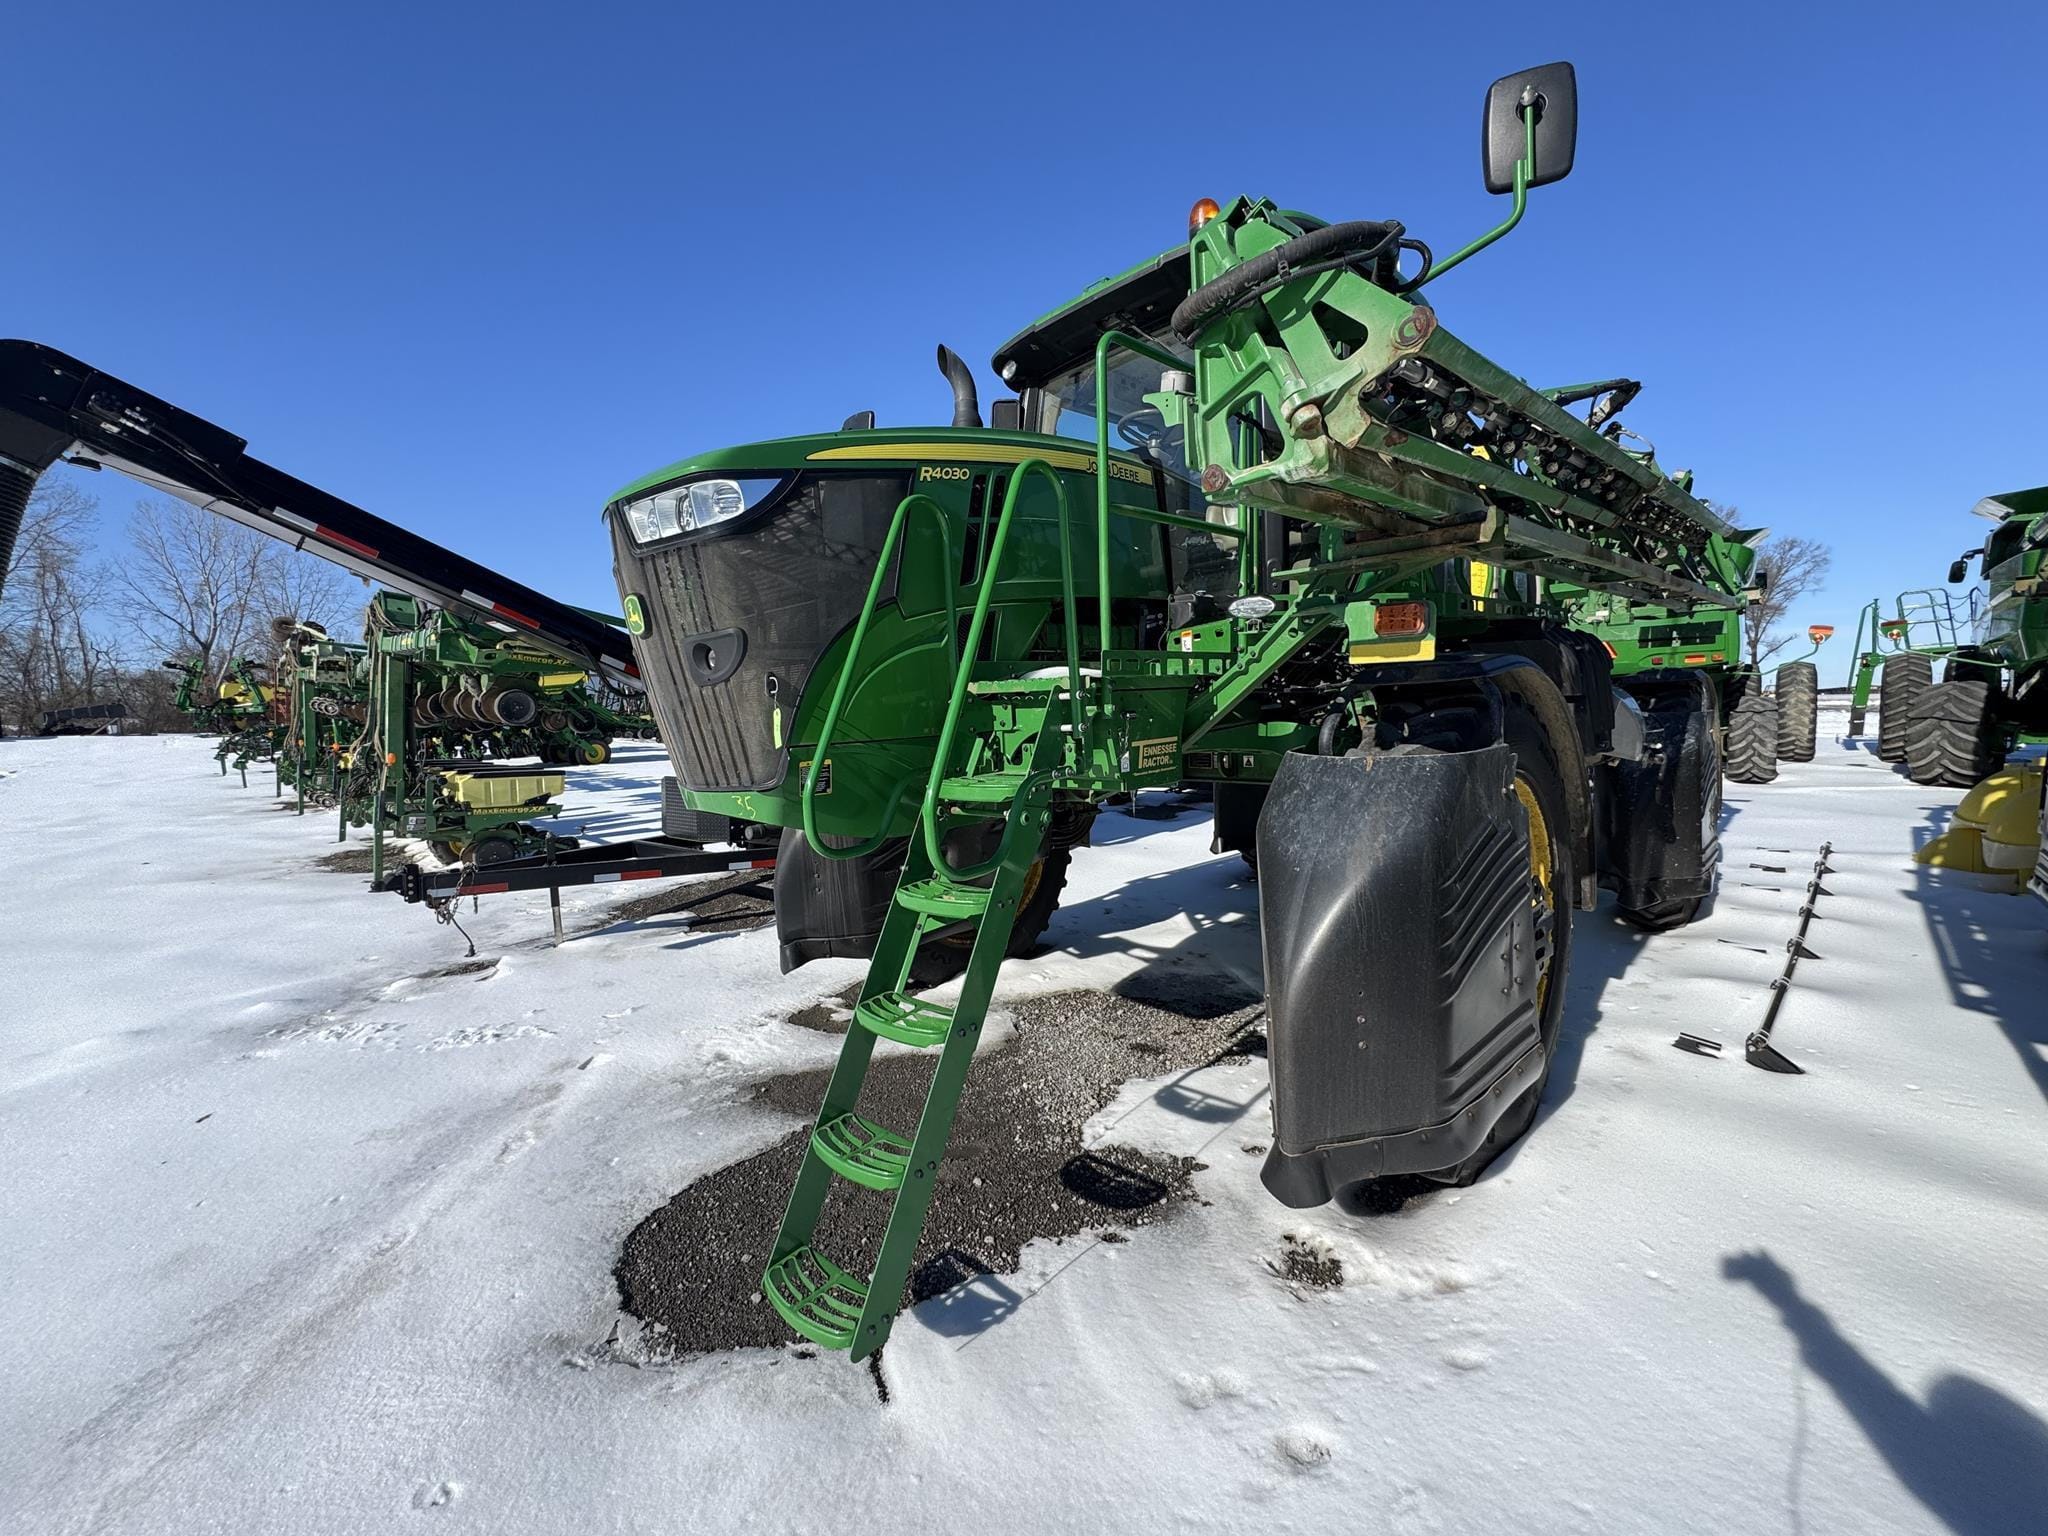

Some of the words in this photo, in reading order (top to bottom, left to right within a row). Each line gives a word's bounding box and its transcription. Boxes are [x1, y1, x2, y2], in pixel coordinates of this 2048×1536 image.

[919, 466, 970, 481] R4030
[1086, 457, 1111, 475] JO
[1111, 462, 1140, 481] DEERE
[473, 806, 530, 816] MaxEmerge
[529, 805, 546, 813] XP
